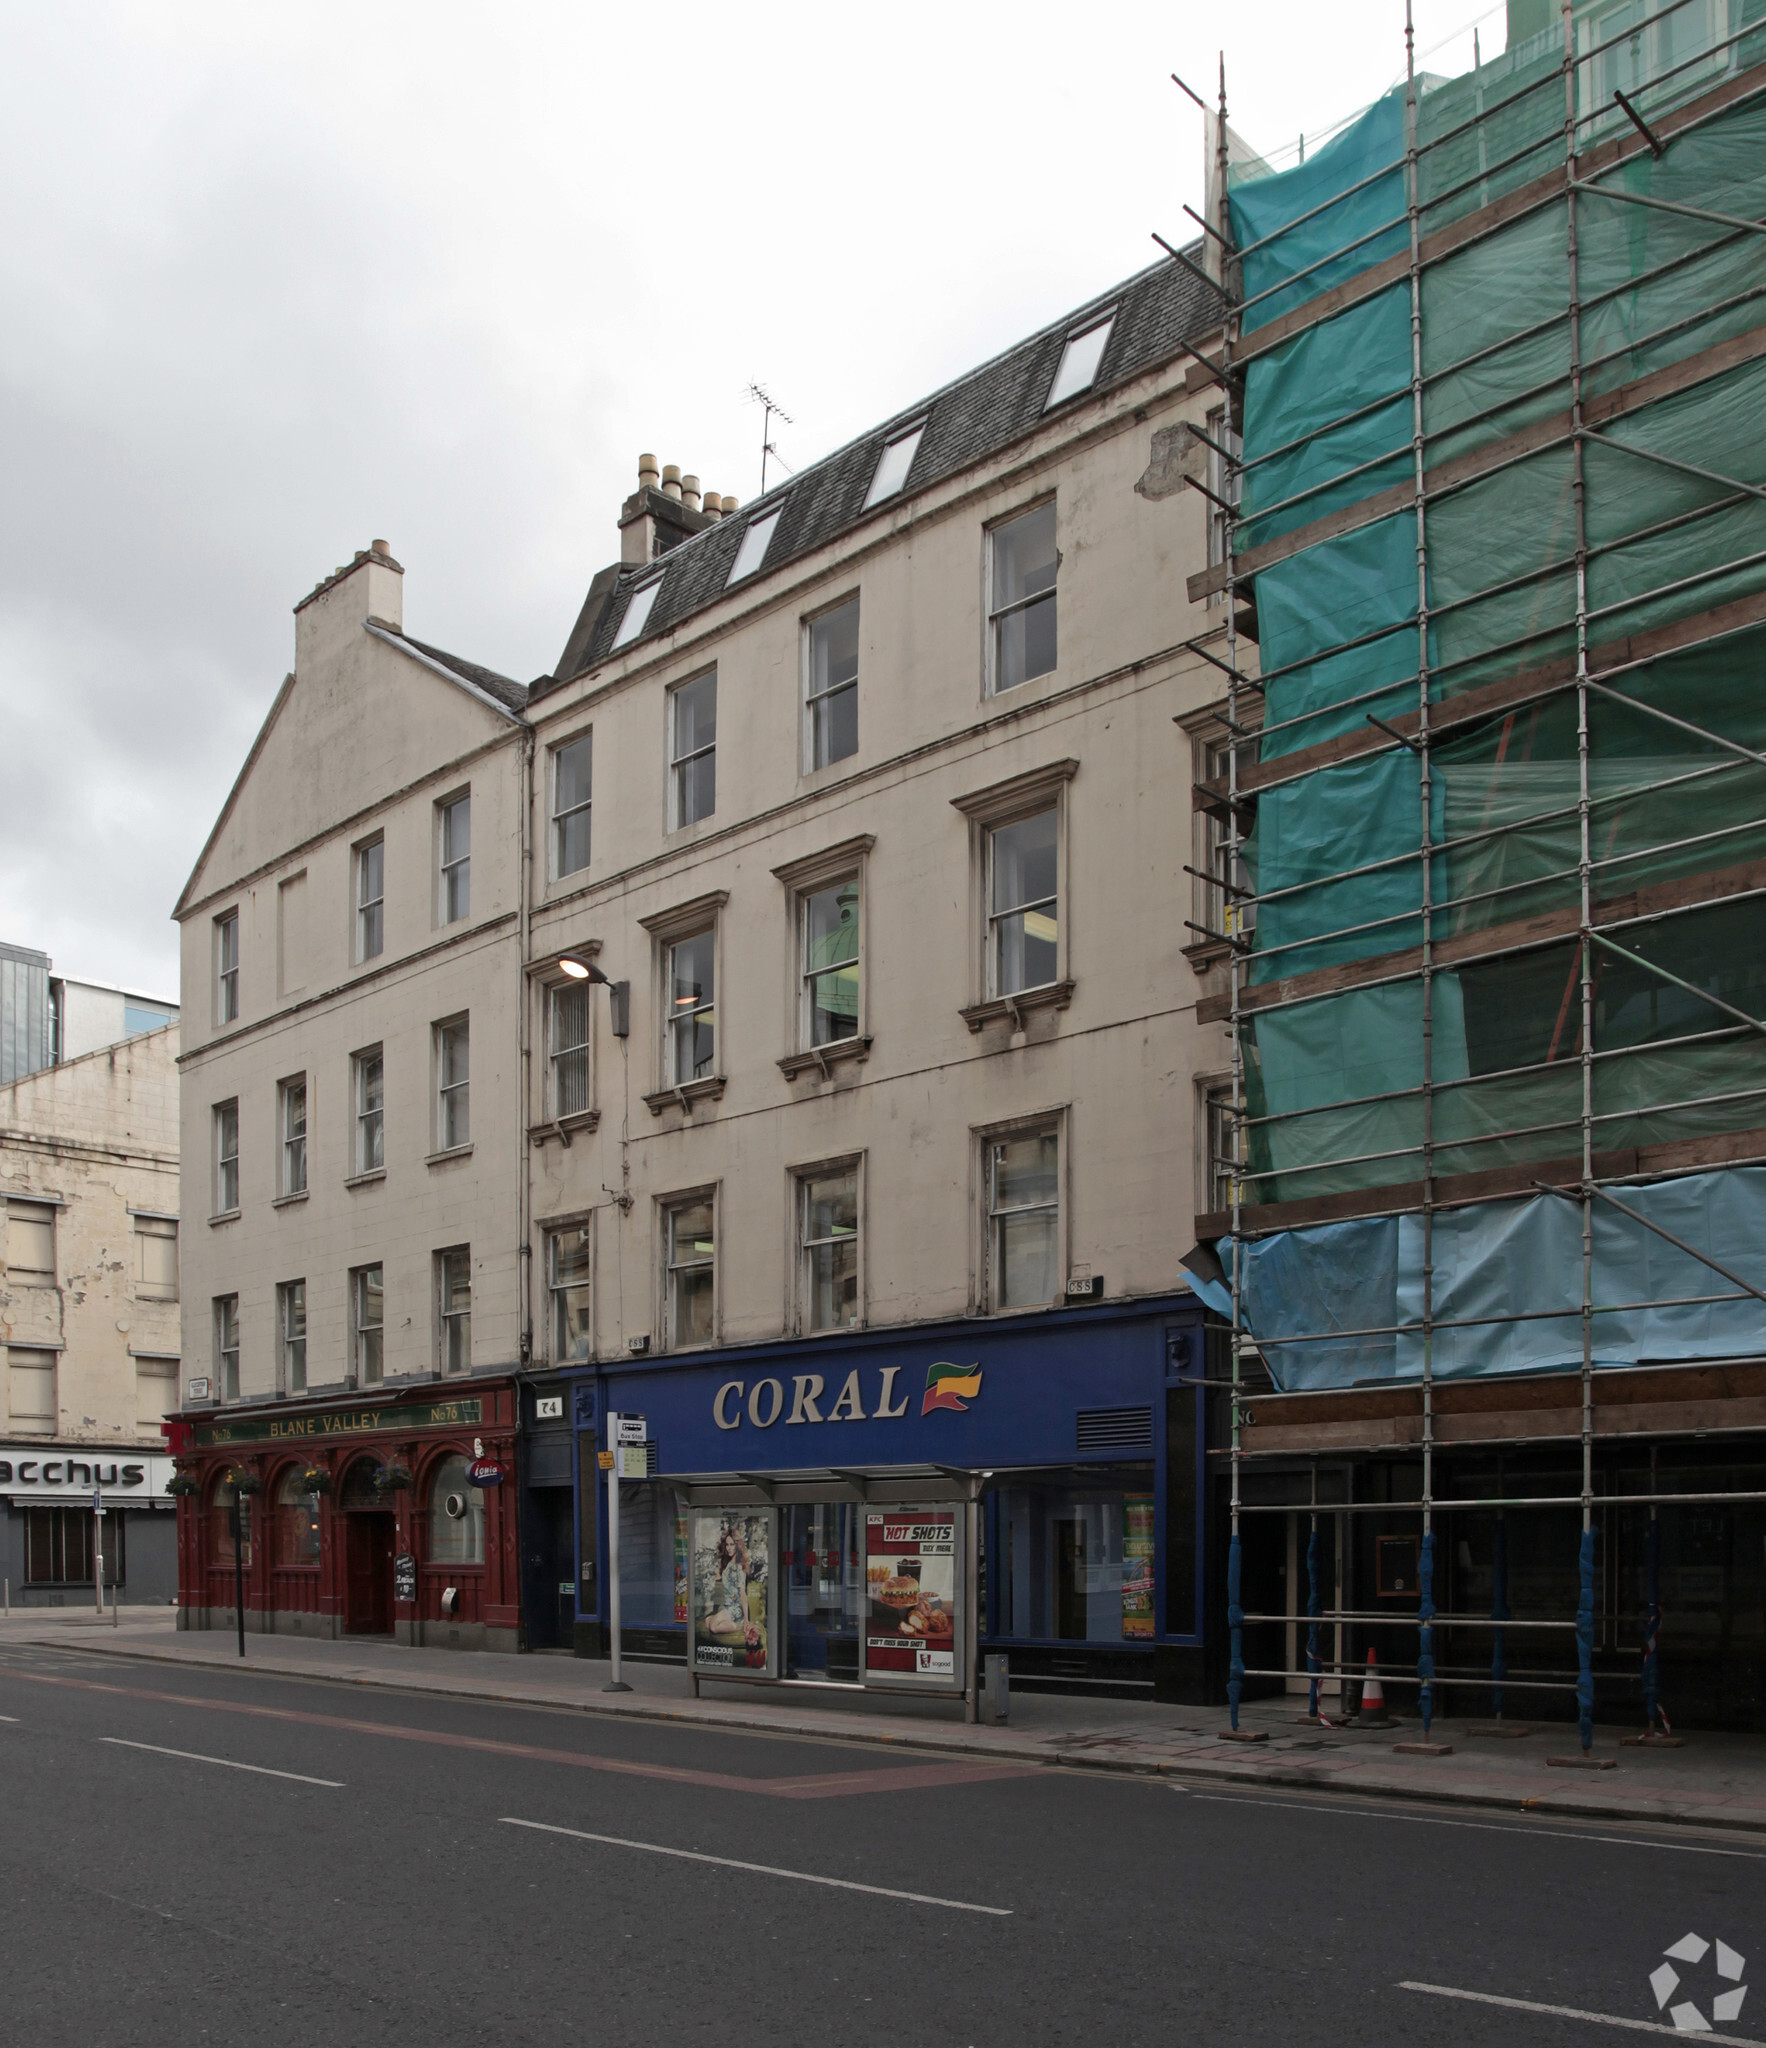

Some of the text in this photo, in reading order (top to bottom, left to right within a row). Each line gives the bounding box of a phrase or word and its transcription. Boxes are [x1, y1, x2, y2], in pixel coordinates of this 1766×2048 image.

[712, 1366, 909, 1430] CORAL
[270, 1412, 381, 1437] BLANE VALLEY
[885, 1526, 952, 1540] HOT SHOTS
[703, 1646, 733, 1655] CONSCIOUS
